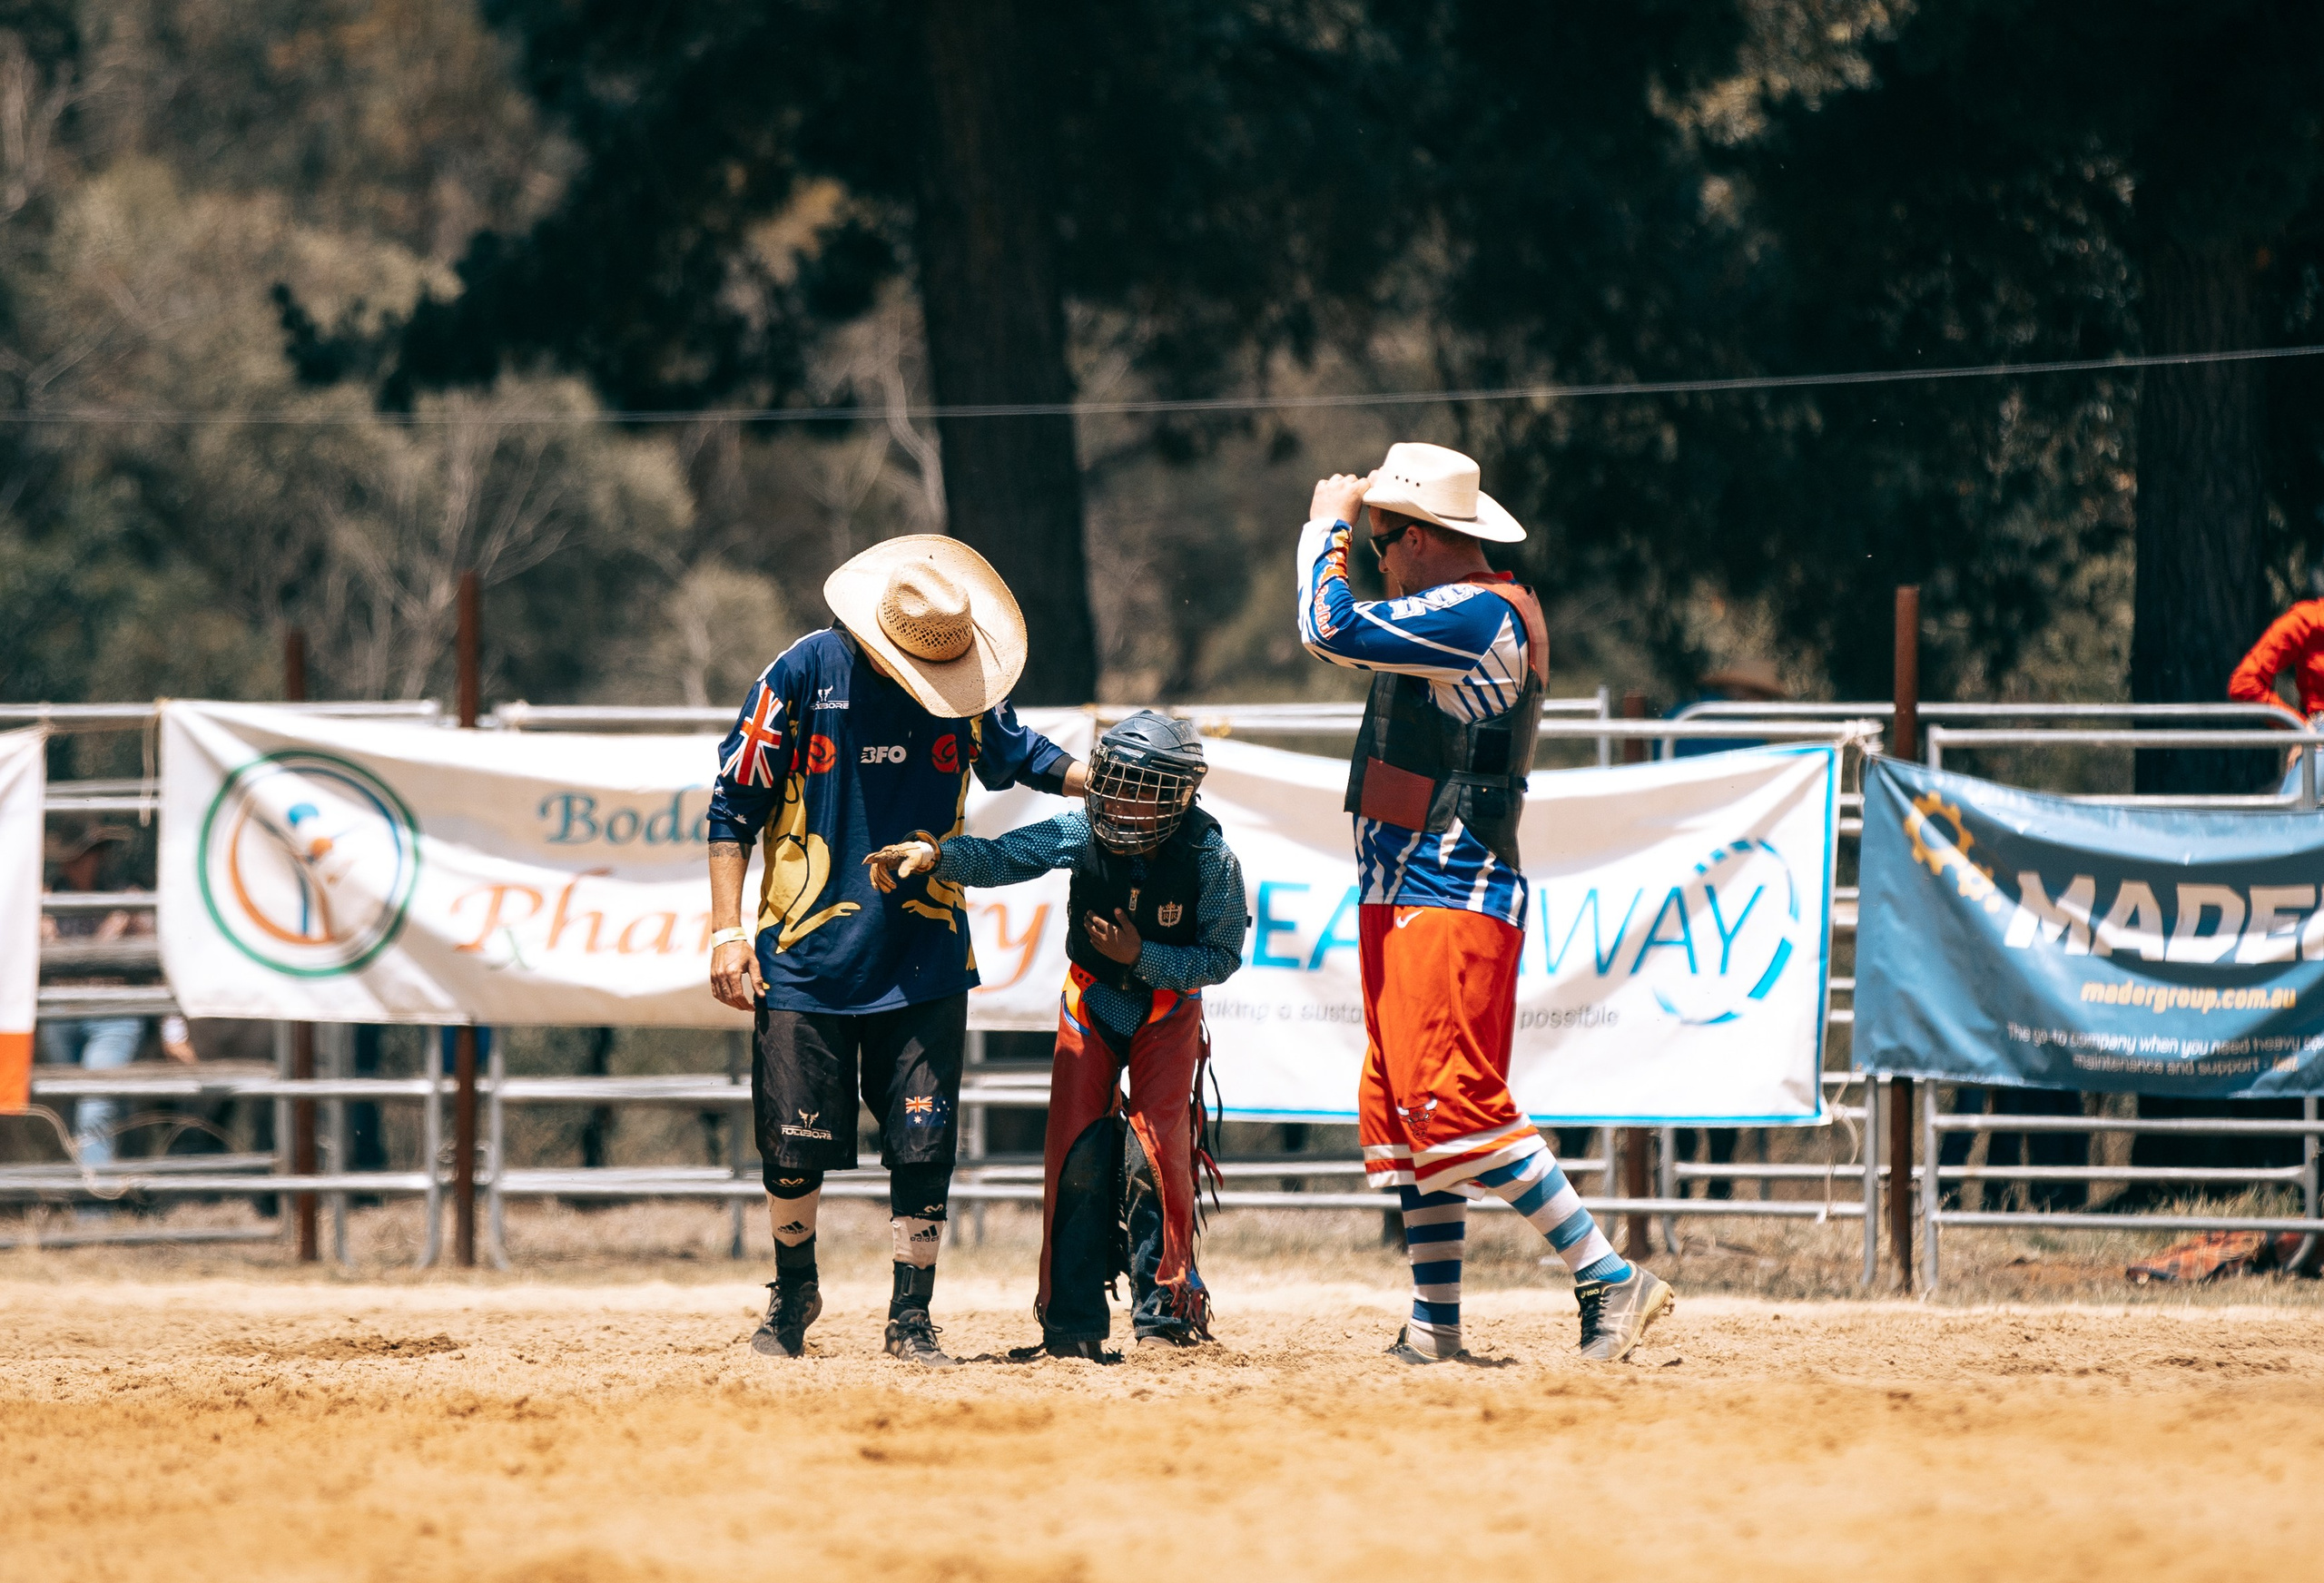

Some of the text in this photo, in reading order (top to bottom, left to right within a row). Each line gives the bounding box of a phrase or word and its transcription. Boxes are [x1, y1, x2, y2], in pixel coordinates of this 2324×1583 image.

[860, 745, 907, 763] BFO
[2080, 978, 2297, 1015] madergroup.com.au
[1202, 999, 1268, 1023] aking
[1520, 1004, 1620, 1030] possible
[2139, 1033, 2179, 1055] when
[2181, 1037, 2210, 1059] you
[2166, 1057, 2195, 1077] and
[2197, 1056, 2259, 1078] support
